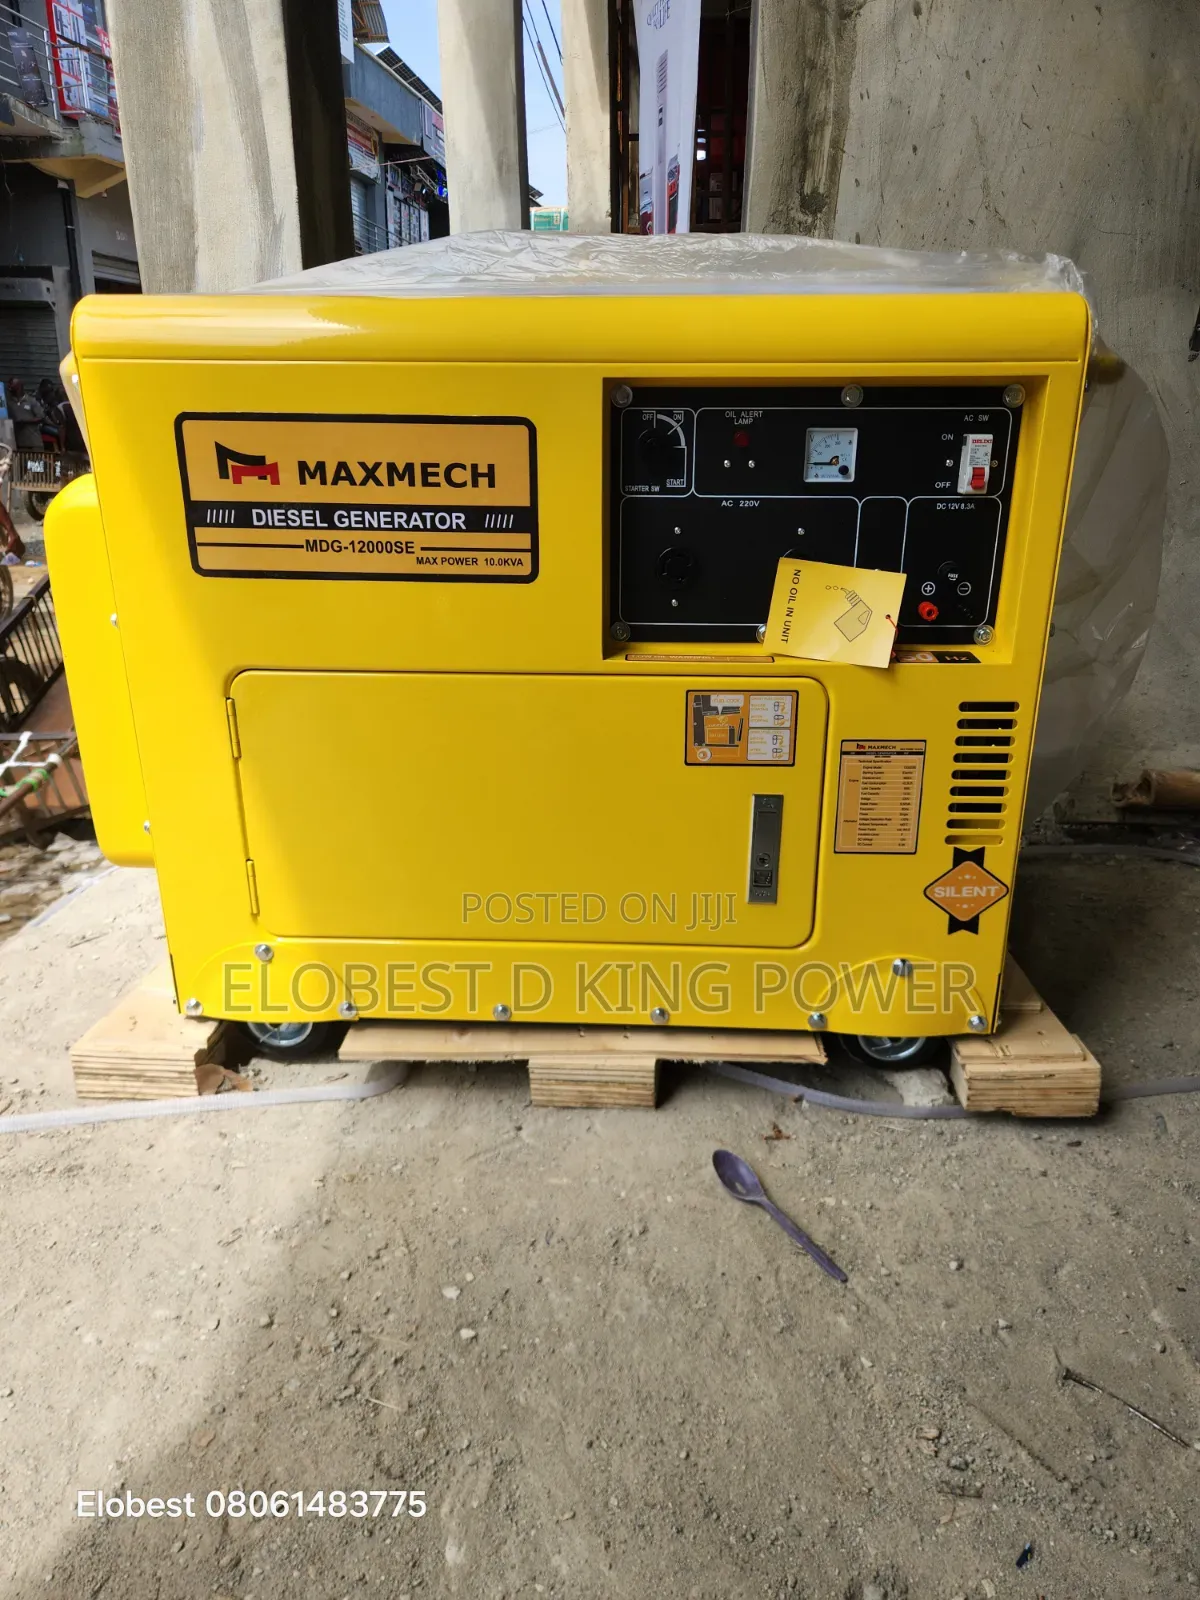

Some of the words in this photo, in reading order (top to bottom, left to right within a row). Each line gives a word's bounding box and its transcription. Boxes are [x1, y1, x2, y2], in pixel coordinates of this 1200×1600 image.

[642, 413, 654, 421] OFF
[673, 413, 682, 421] ON
[725, 410, 736, 418] OIL
[740, 410, 763, 418] ALERT
[964, 414, 974, 422] AC
[978, 414, 990, 422] SW
[941, 433, 954, 441] ON
[297, 460, 496, 489] MAXMECH
[651, 485, 660, 493] SW
[935, 481, 951, 489] OFF
[721, 500, 734, 508] AC
[740, 500, 760, 508] 220V
[252, 508, 328, 529] DIESEL
[333, 510, 467, 531] GENERATOR
[305, 539, 416, 555] MDG-12000SE
[416, 556, 439, 566] MAX
[440, 557, 479, 567] POWER
[484, 557, 524, 567] 10.0KVA
[791, 568, 802, 585] NO
[787, 588, 798, 605] OIL
[785, 606, 795, 618] IN
[780, 618, 793, 644] UNIT
[944, 654, 969, 662] Hz
[933, 885, 1000, 899] SILENT
